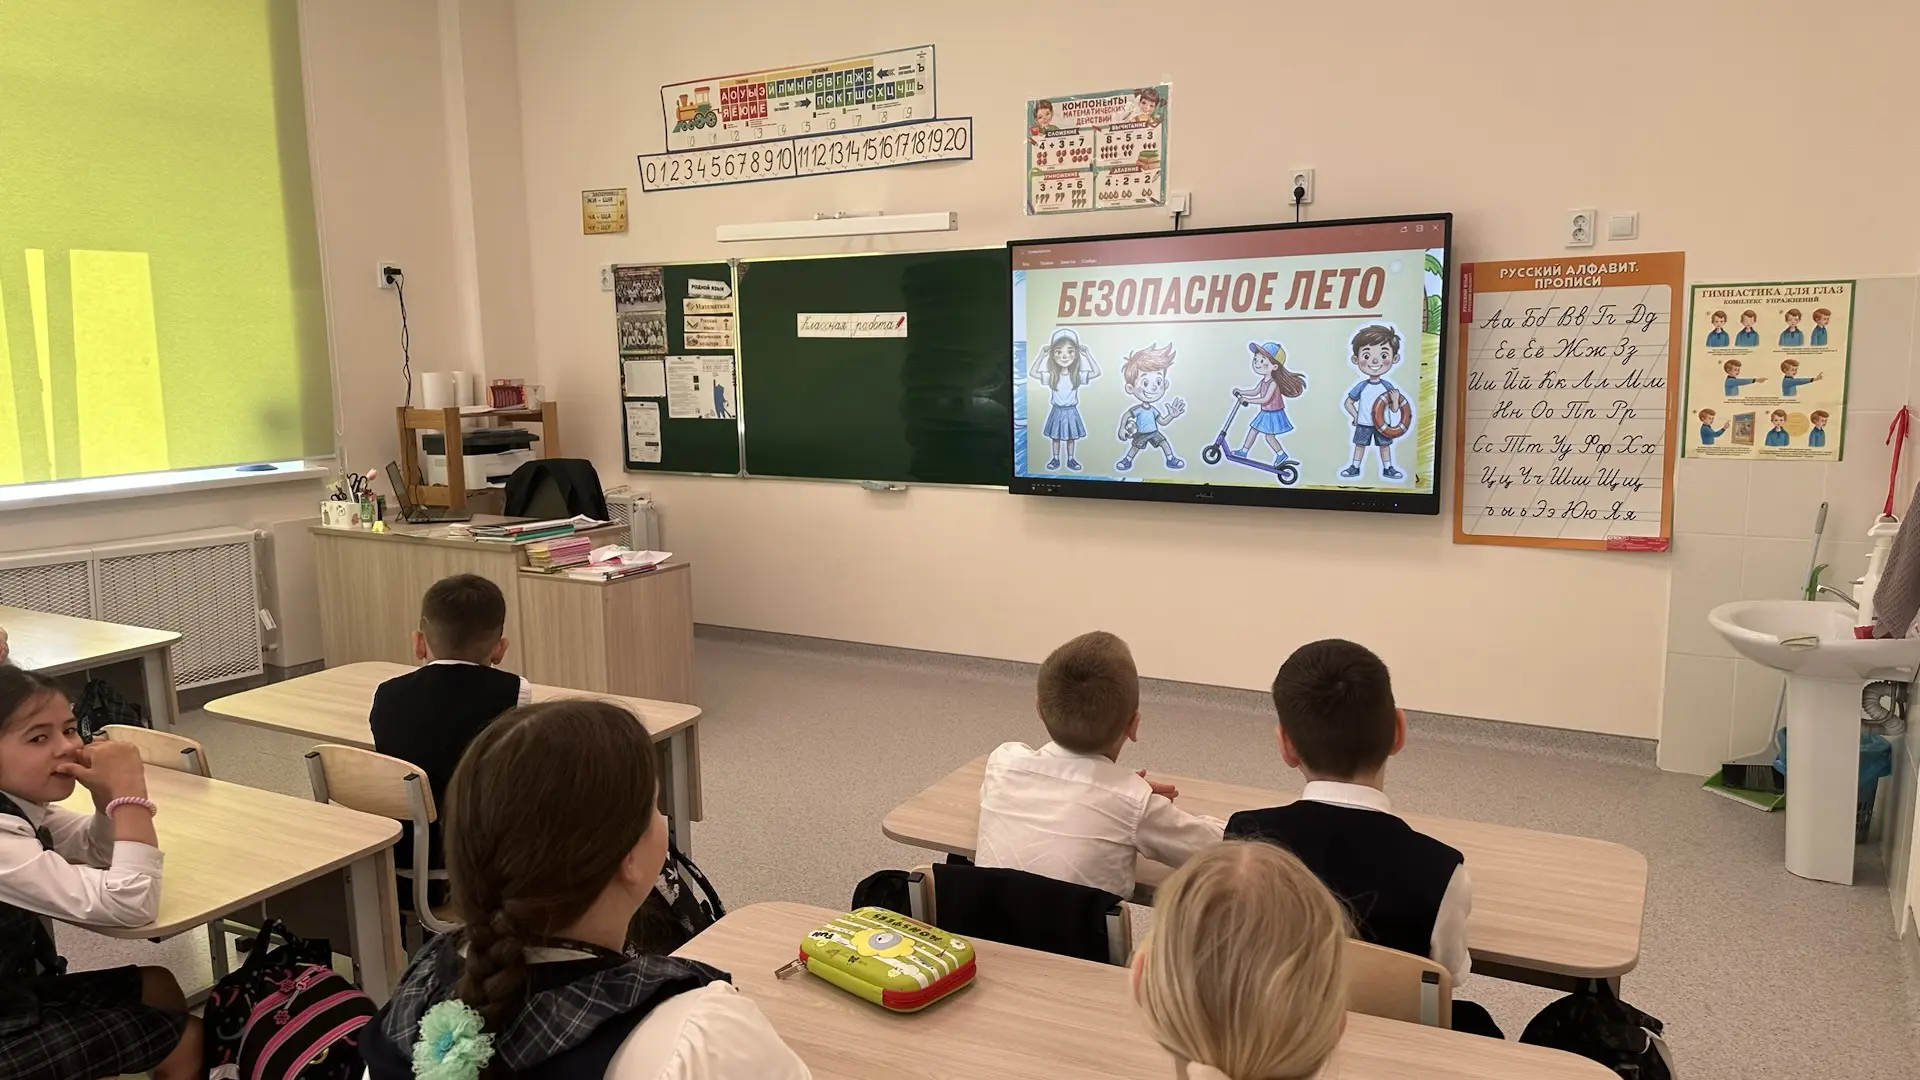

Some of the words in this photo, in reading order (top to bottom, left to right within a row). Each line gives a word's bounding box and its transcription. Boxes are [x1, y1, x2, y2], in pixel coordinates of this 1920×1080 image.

[731, 91, 736, 99] О
[740, 89, 746, 98] У
[749, 88, 756, 97] Ы
[759, 87, 765, 95] Э
[768, 84, 774, 94] Й
[779, 85, 784, 93] Л
[788, 83, 794, 91] М
[807, 81, 813, 89] Р
[817, 79, 822, 87] Б
[827, 78, 832, 86] В
[837, 76, 841, 84] Г
[846, 75, 852, 83] Д
[855, 73, 863, 82] Ж
[867, 71, 872, 80] З
[917, 64, 924, 72] Ъ
[817, 96, 823, 105] П
[826, 95, 833, 103] Ф
[836, 94, 842, 102] К
[847, 93, 852, 101] Т
[856, 91, 864, 100] Ш
[867, 90, 873, 98] С
[877, 88, 884, 96] Х
[887, 87, 894, 96] Ц
[897, 85, 903, 93] Ч
[906, 83, 915, 93] Щ
[1062, 96, 1127, 110] КОМПОНЕНТЫ
[723, 109, 729, 117] Я
[739, 107, 748, 115] Ю
[751, 106, 756, 114] И
[1063, 105, 1126, 118] МАТЕМАТИЧЕСКИХ
[1076, 115, 1112, 126] ДЕЙСТВИЙ
[798, 146, 808, 168] 11
[812, 144, 826, 166] 12
[829, 142, 843, 164] 13
[846, 140, 860, 162] 14
[863, 138, 877, 161] 15
[880, 136, 892, 158] 16
[896, 133, 910, 156] 17
[912, 131, 925, 154] 18
[928, 129, 943, 152] 19
[944, 128, 967, 150] 20
[647, 163, 655, 183] 0
[661, 162, 666, 182] 1
[671, 161, 679, 181] 2
[685, 159, 692, 179] 3
[698, 158, 705, 178] 4
[712, 156, 720, 177] 5
[725, 155, 734, 175] 6
[738, 153, 746, 174] 7
[751, 152, 759, 172] 8
[765, 150, 773, 171] 9
[777, 148, 791, 170] 10
[1500, 263, 1561, 279] РУССКИЙ
[1566, 262, 1639, 275] АЛФАВИТ.
[1058, 272, 1278, 318] БЕЗОПАСНОЕ
[1285, 266, 1386, 311] ЛЕТО
[1535, 276, 1601, 289] ПРОПИСИ
[1702, 288, 1781, 298] ГИМНАСТИКА
[1784, 287, 1810, 295] ДЛЯ
[1813, 286, 1843, 294] ГЛАЗ
[802, 316, 847, 331] Классная
[853, 315, 894, 336] работа
[1480, 309, 1514, 329] Аа
[1522, 307, 1560, 327] Бб
[1557, 306, 1588, 326] Вв
[1592, 305, 1616, 325] Гг
[1626, 303, 1657, 332] Дд
[1495, 340, 1515, 359] Ее
[1523, 337, 1544, 358] Ёё
[1553, 338, 1607, 358] Жж
[1614, 337, 1638, 365] Зз
[1468, 372, 1496, 391] Ии
[1503, 367, 1532, 390] Йй
[1538, 370, 1566, 389] Кк
[1572, 370, 1609, 388] Лл
[1615, 369, 1665, 388] Мм
[1492, 401, 1522, 418] Нн
[1531, 400, 1553, 418] Оо
[1562, 401, 1596, 418] Пп
[1606, 400, 1636, 425] Рр
[1472, 434, 1493, 453] Сс
[1499, 435, 1543, 453] Тт
[1550, 434, 1572, 461] Уу
[1579, 434, 1611, 462] Фф
[1617, 435, 1655, 454] Хх
[1481, 466, 1513, 489] Цц
[1519, 467, 1544, 485] Чч
[1550, 467, 1591, 486] Шш
[1597, 468, 1643, 492] Щщ
[1486, 506, 1494, 515] ъ
[1502, 507, 1515, 516] ы
[1521, 507, 1527, 516] ь
[1533, 500, 1555, 518] Ээ
[1562, 501, 1597, 519] Юю
[1604, 501, 1636, 520] Яя
